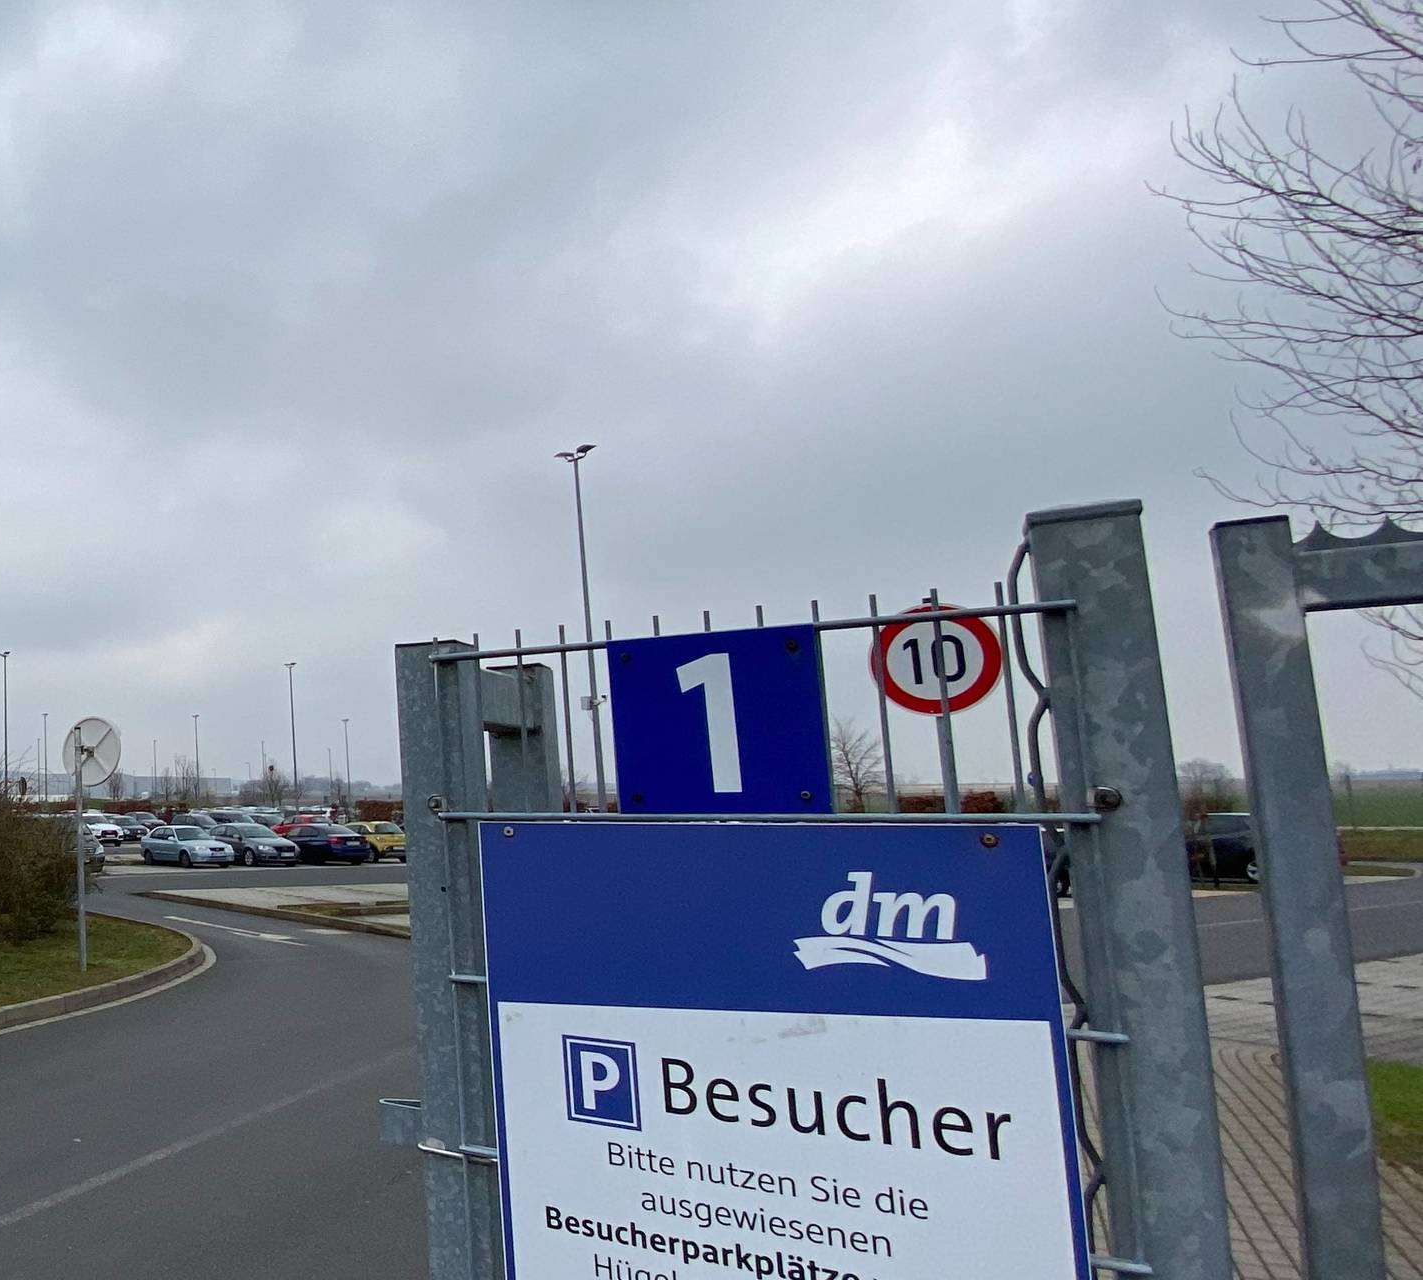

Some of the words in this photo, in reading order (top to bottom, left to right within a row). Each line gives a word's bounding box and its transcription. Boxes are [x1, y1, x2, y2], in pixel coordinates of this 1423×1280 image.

[902, 634, 966, 685] 10
[676, 652, 743, 793] 1
[820, 870, 957, 940] dm
[580, 1051, 621, 1110] P
[660, 1057, 1013, 1161] Besucher
[607, 1141, 676, 1176] Bitte
[686, 1159, 797, 1198] nutzen
[809, 1175, 861, 1208] Sie
[875, 1186, 929, 1220] die
[640, 1191, 893, 1257] ausgewiesenen
